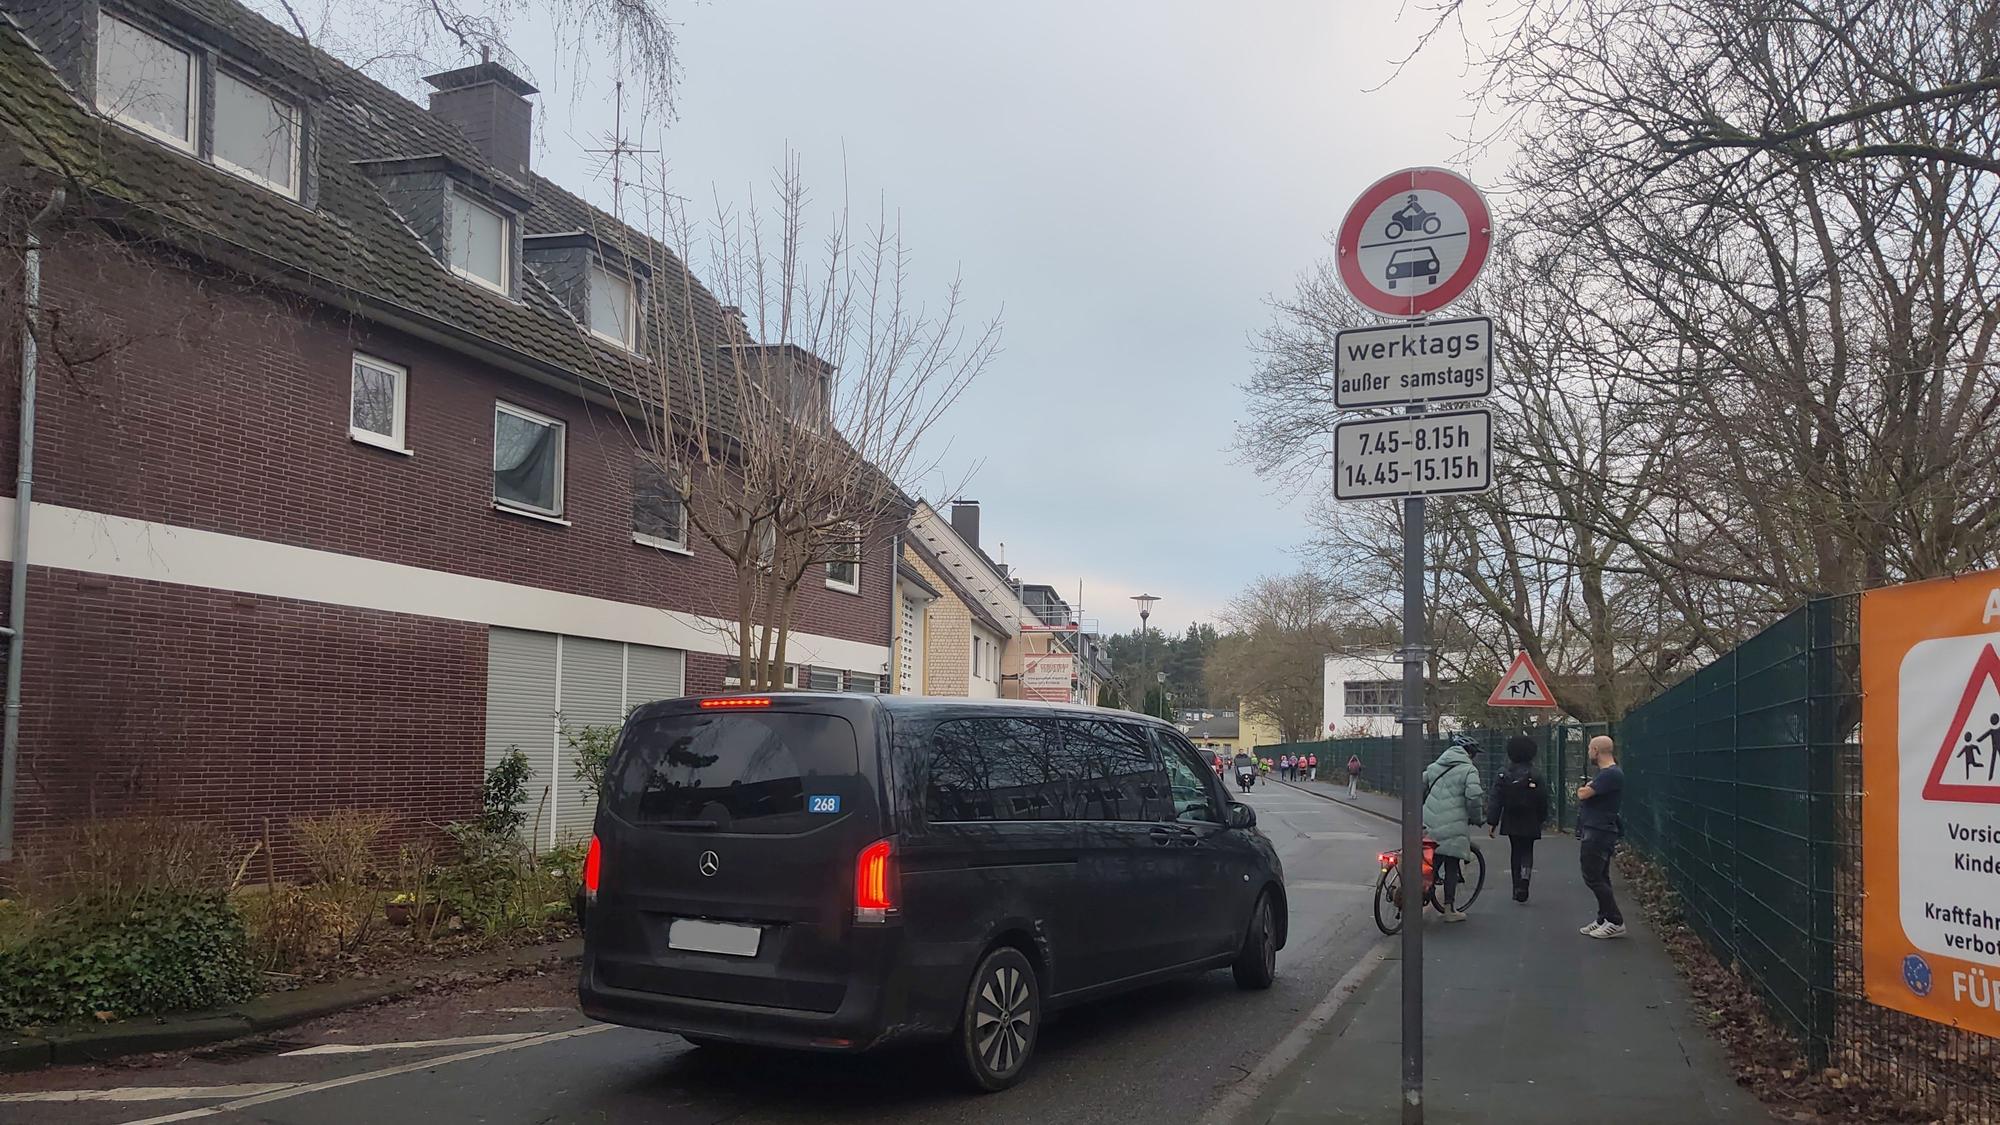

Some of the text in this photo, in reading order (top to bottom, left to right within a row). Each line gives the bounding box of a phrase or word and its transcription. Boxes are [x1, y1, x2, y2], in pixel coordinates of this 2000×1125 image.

[1348, 333, 1480, 361] werktags
[1341, 367, 1485, 393] außer samstags
[814, 798, 835, 811] 268
